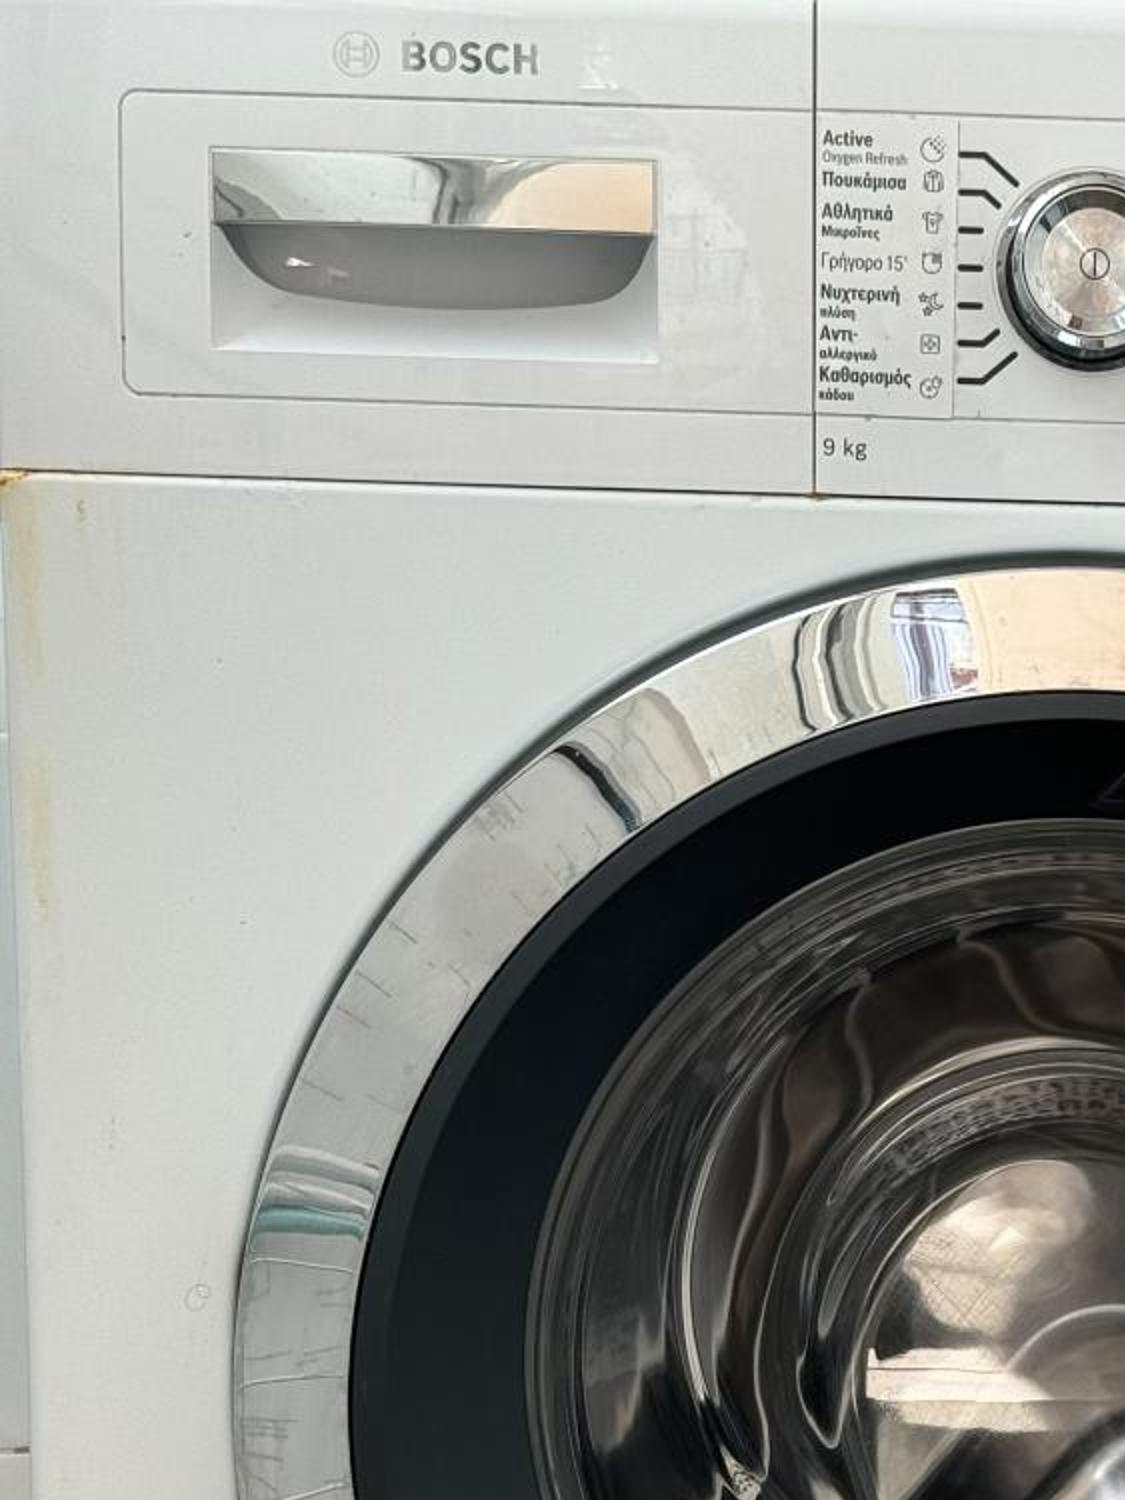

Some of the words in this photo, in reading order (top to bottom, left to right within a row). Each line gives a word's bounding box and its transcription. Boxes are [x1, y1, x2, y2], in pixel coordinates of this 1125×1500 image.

[401, 40, 539, 76] BOSCH
[823, 129, 874, 147] Active
[822, 171, 907, 191] Πουκάμισα
[821, 202, 894, 224] Αθλητικά
[821, 251, 884, 273] Γρήγορο
[820, 283, 900, 306] Νυχτερινή
[819, 365, 913, 390] Καθαρισμός
[823, 438, 835, 456] 9
[843, 438, 867, 461] kg
